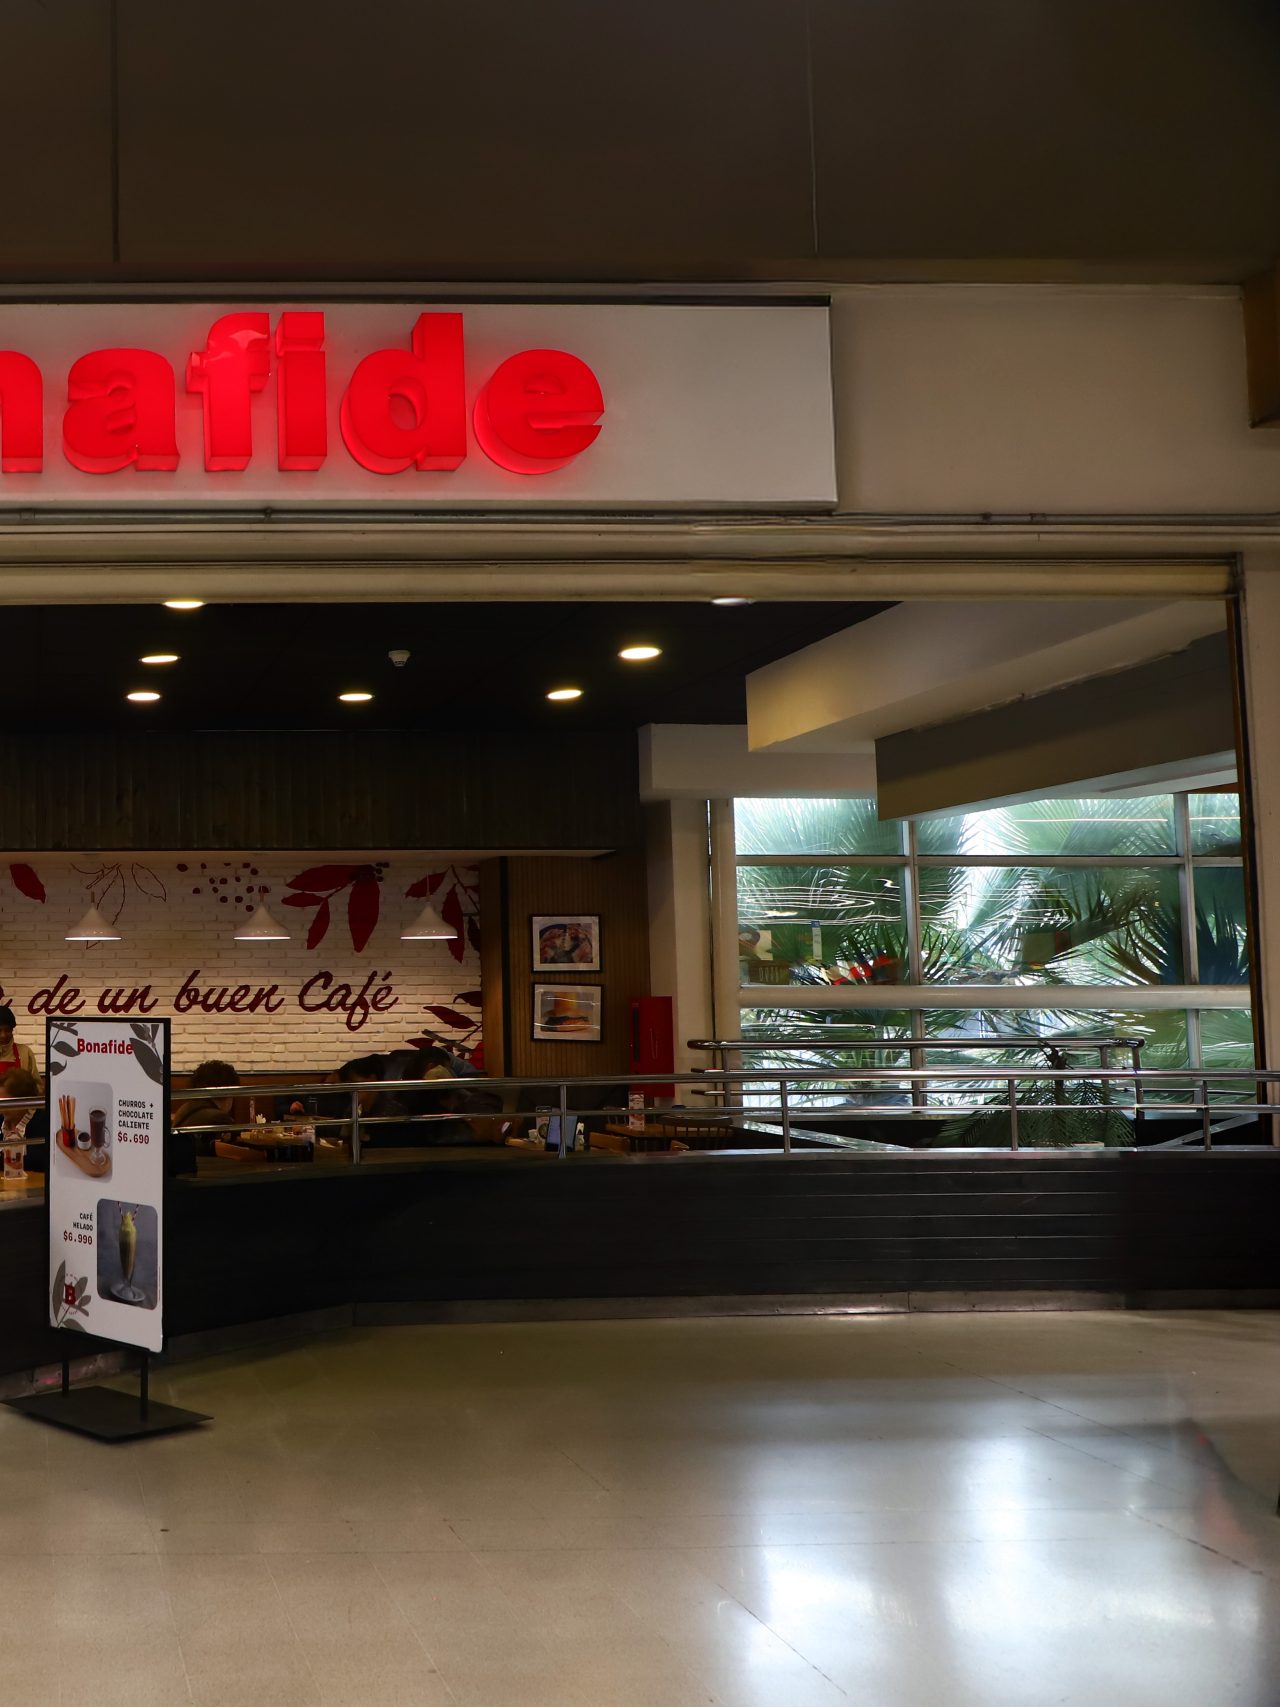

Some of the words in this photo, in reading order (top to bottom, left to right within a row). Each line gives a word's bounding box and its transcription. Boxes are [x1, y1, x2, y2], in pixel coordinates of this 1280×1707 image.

[27, 974, 86, 1014] de
[97, 984, 158, 1013] un
[174, 970, 285, 1013] buen
[298, 970, 399, 1031] Café
[77, 1038, 134, 1054] Bonafide
[118, 1099, 146, 1109] CHURROS
[118, 1109, 154, 1120] CHOCOLATE
[118, 1120, 150, 1130] CALIENTE
[117, 1131, 150, 1145] $6.690
[79, 1212, 93, 1221] CAFÉ
[73, 1222, 93, 1231] HELADO
[63, 1230, 93, 1245] $6.990
